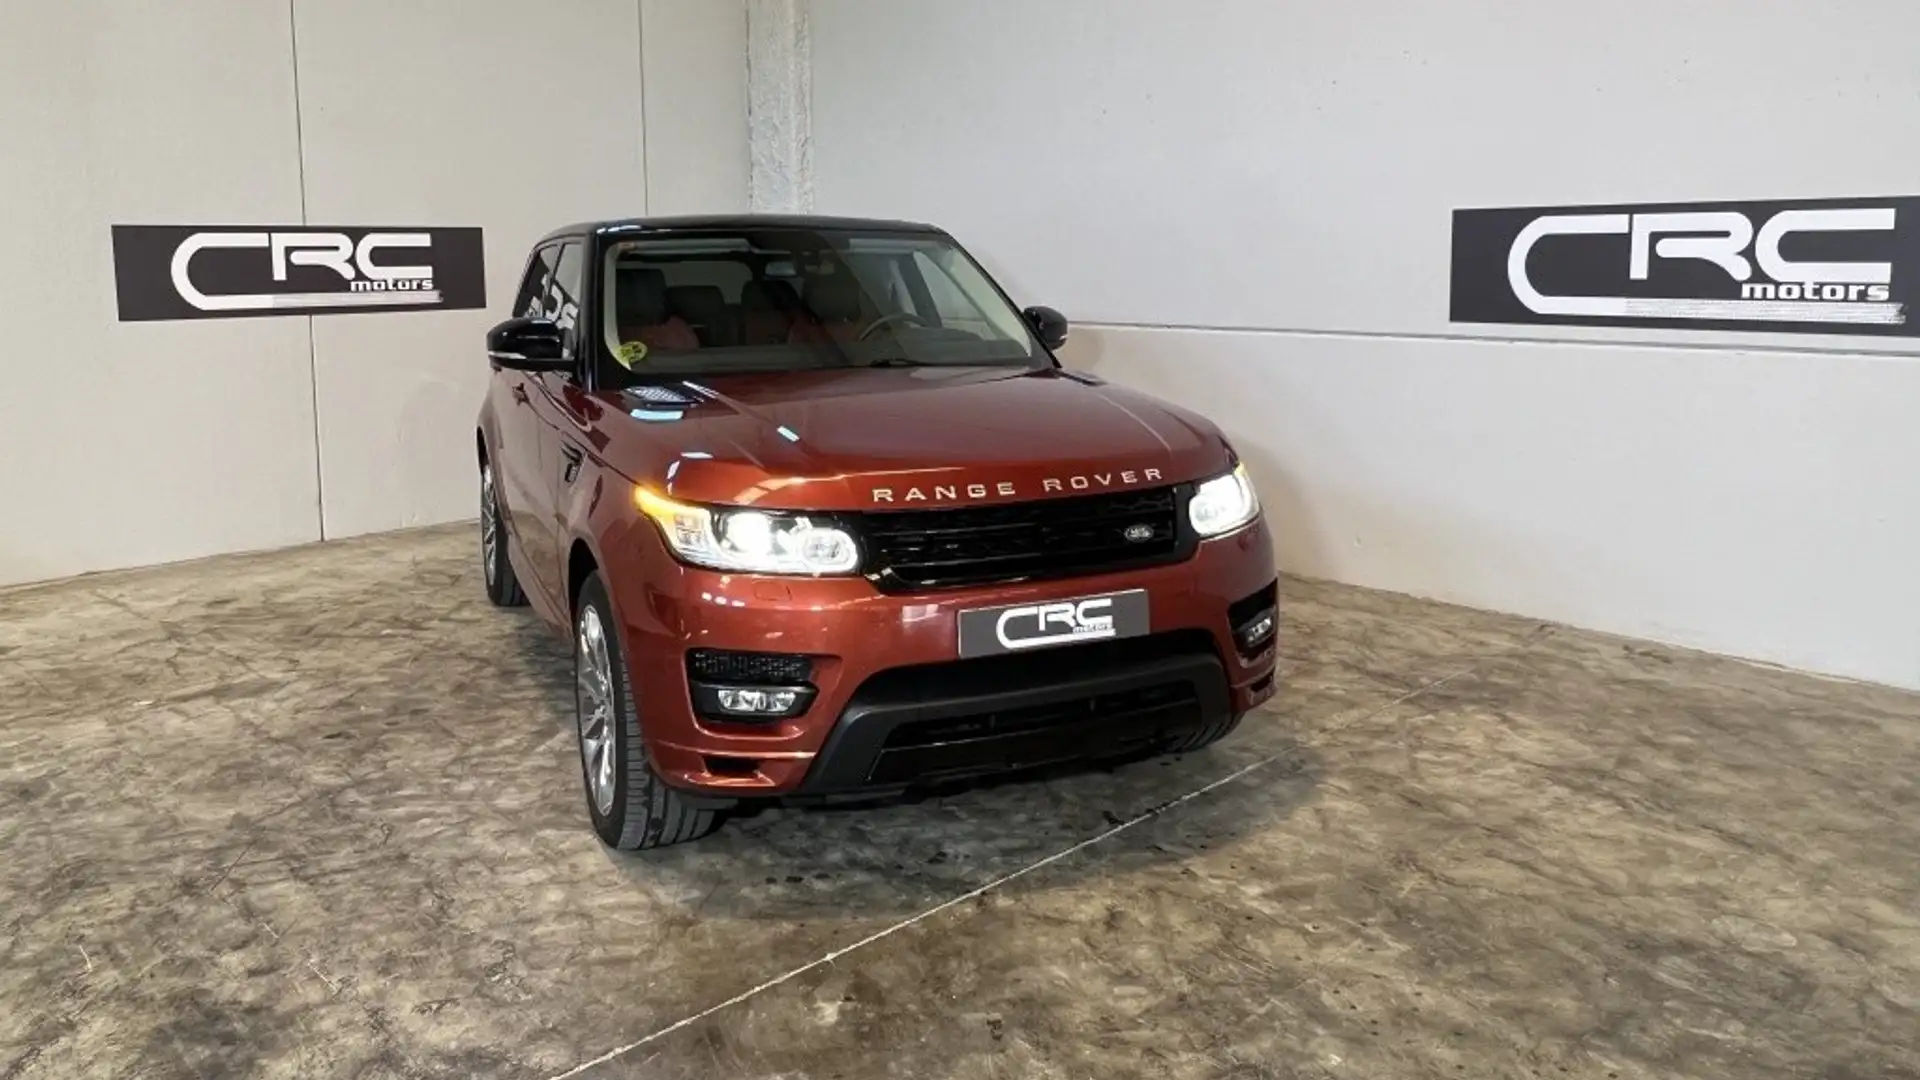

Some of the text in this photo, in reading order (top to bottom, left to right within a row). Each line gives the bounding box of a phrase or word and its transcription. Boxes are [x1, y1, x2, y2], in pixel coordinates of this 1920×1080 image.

[171, 232, 434, 311] CRC
[350, 278, 434, 292] motors
[1507, 208, 1896, 324] CRC
[1740, 282, 1890, 302] motors
[872, 468, 1162, 502] RANGE ROVER
[996, 598, 1116, 650] CRC
